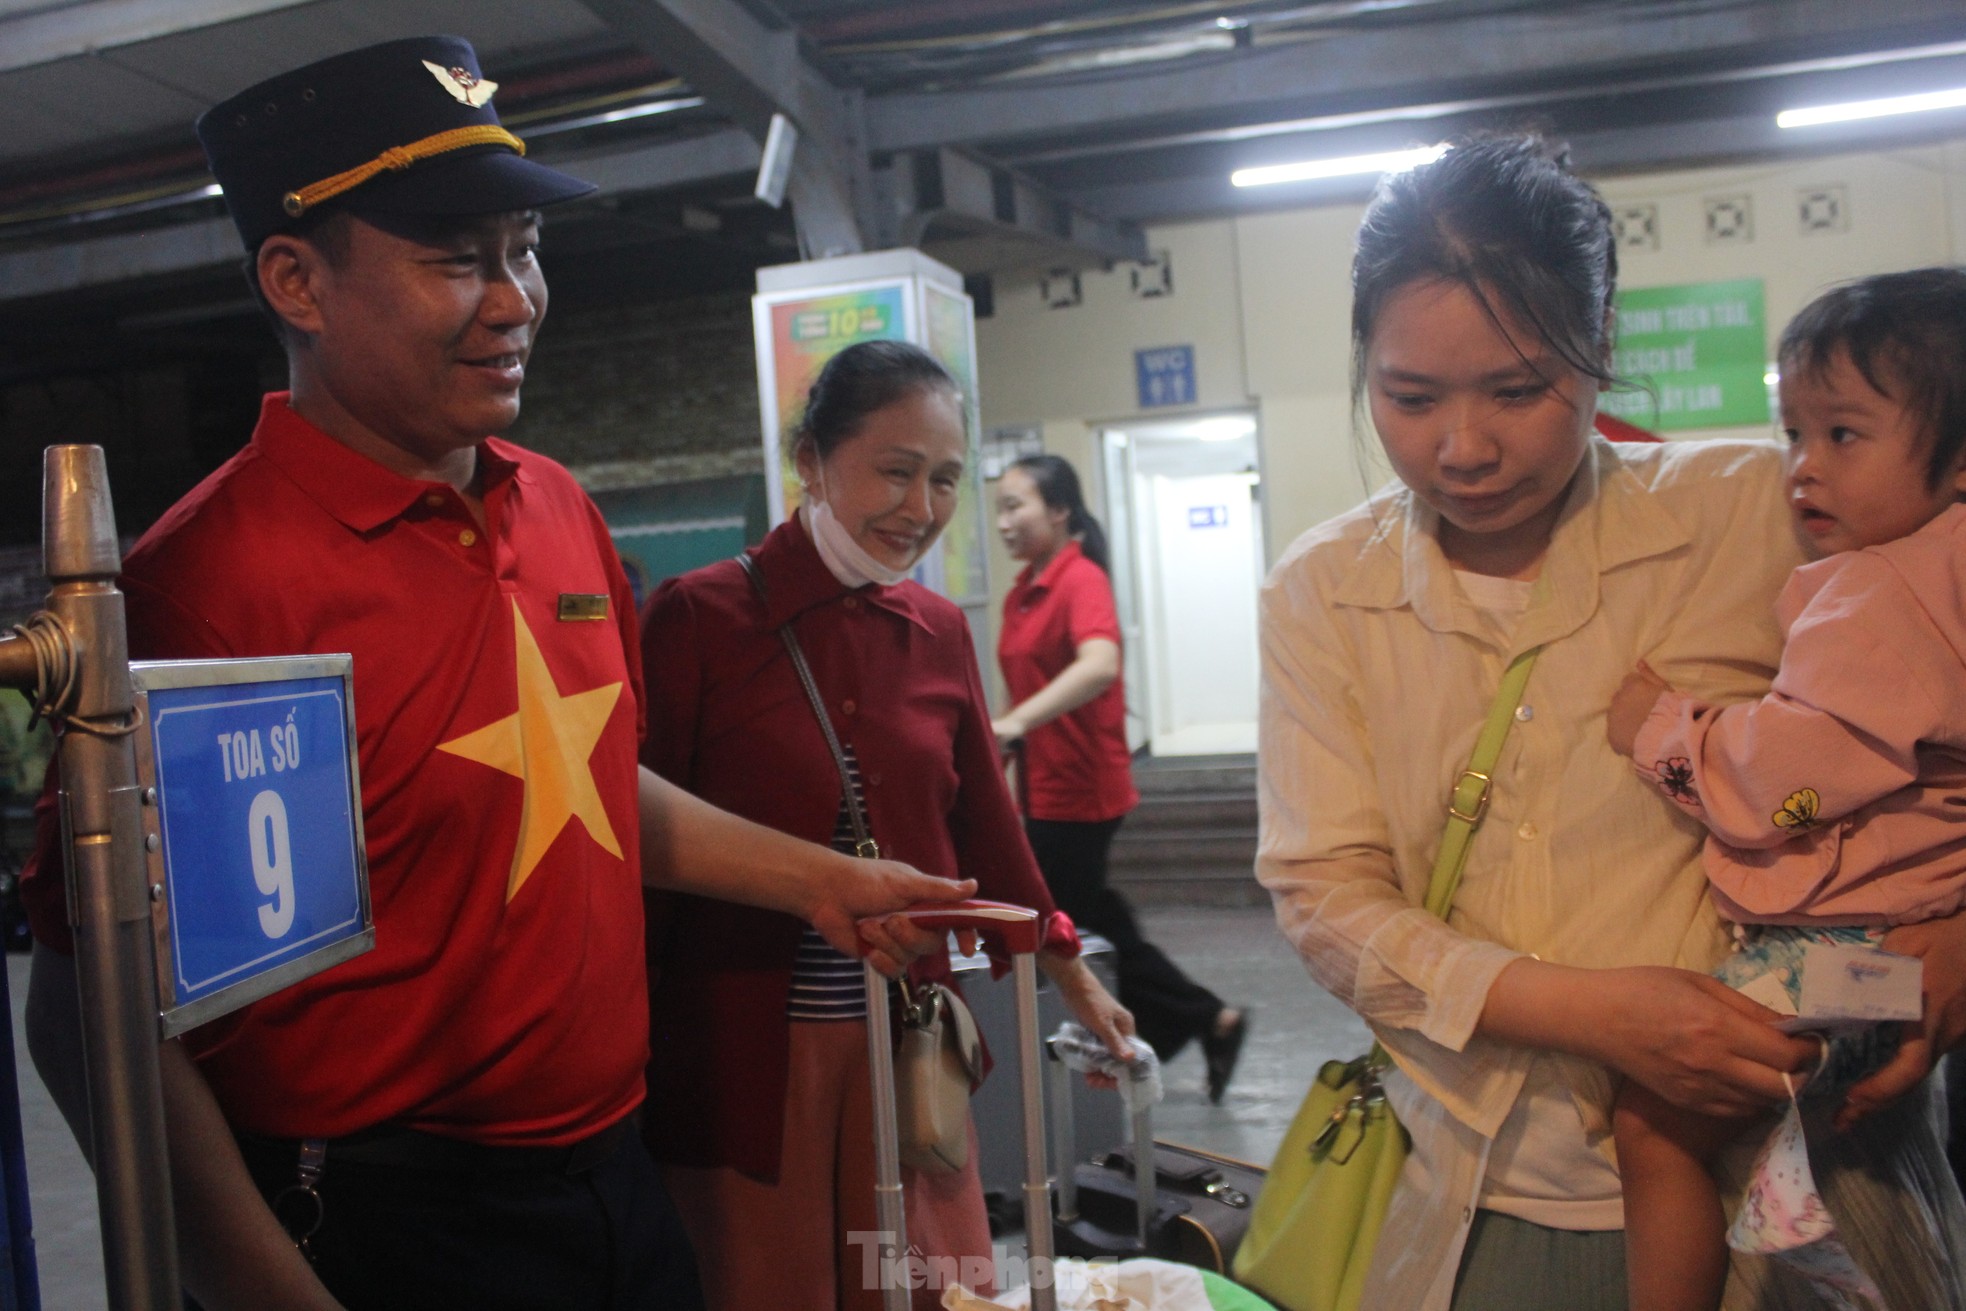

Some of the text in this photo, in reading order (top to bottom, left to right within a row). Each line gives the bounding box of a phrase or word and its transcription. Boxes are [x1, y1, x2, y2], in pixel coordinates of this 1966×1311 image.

[1143, 351, 1187, 373] WC
[217, 706, 300, 783] TOA SỐ
[248, 789, 296, 940] 9
